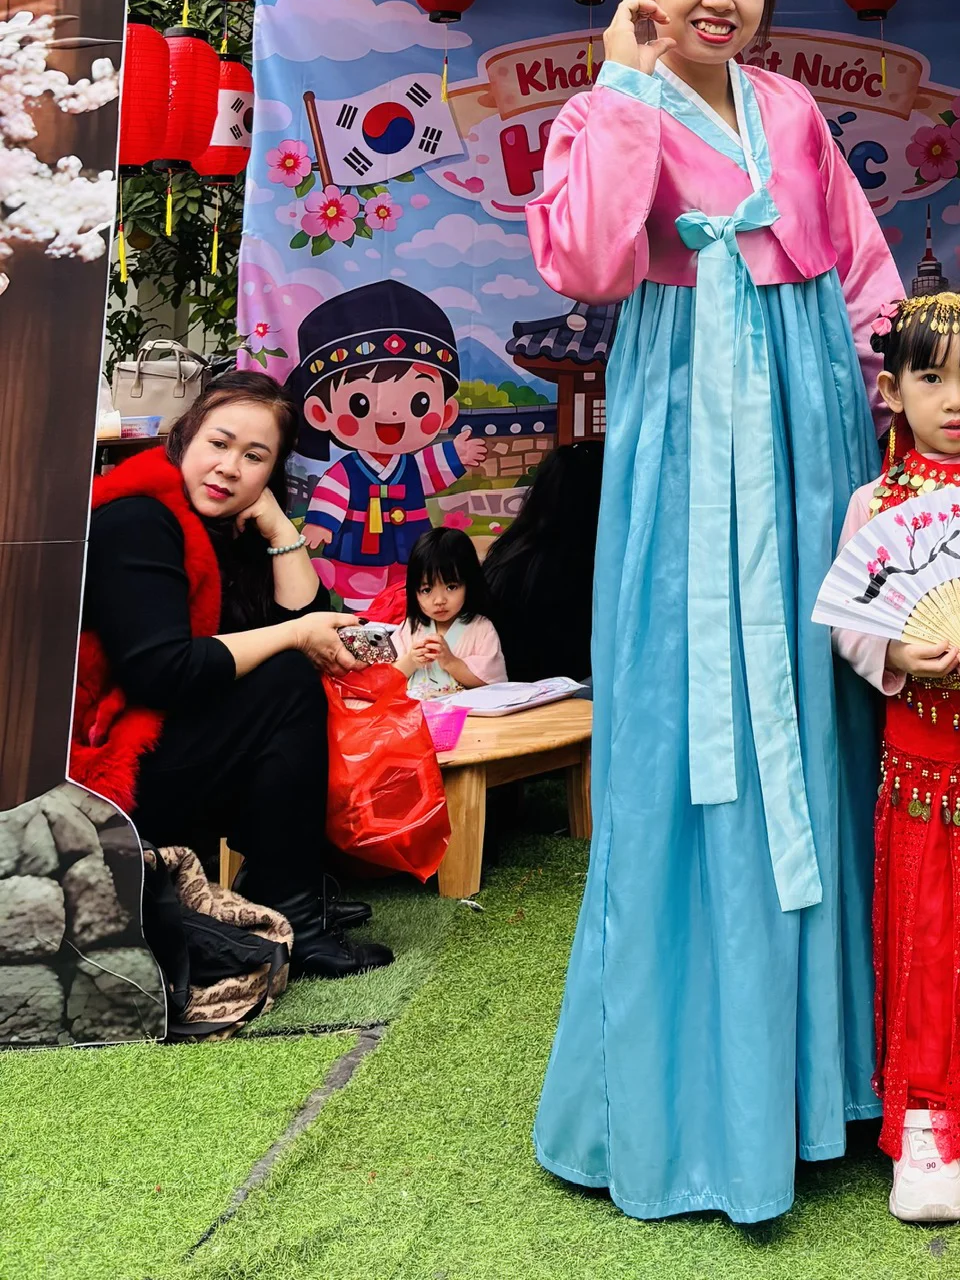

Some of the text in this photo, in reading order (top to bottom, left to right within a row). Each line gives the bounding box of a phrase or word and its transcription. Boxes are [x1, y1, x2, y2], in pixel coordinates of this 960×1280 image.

[733, 41, 782, 72] ất
[792, 51, 885, 97] Nước
[926, 1161, 936, 1170] 90
